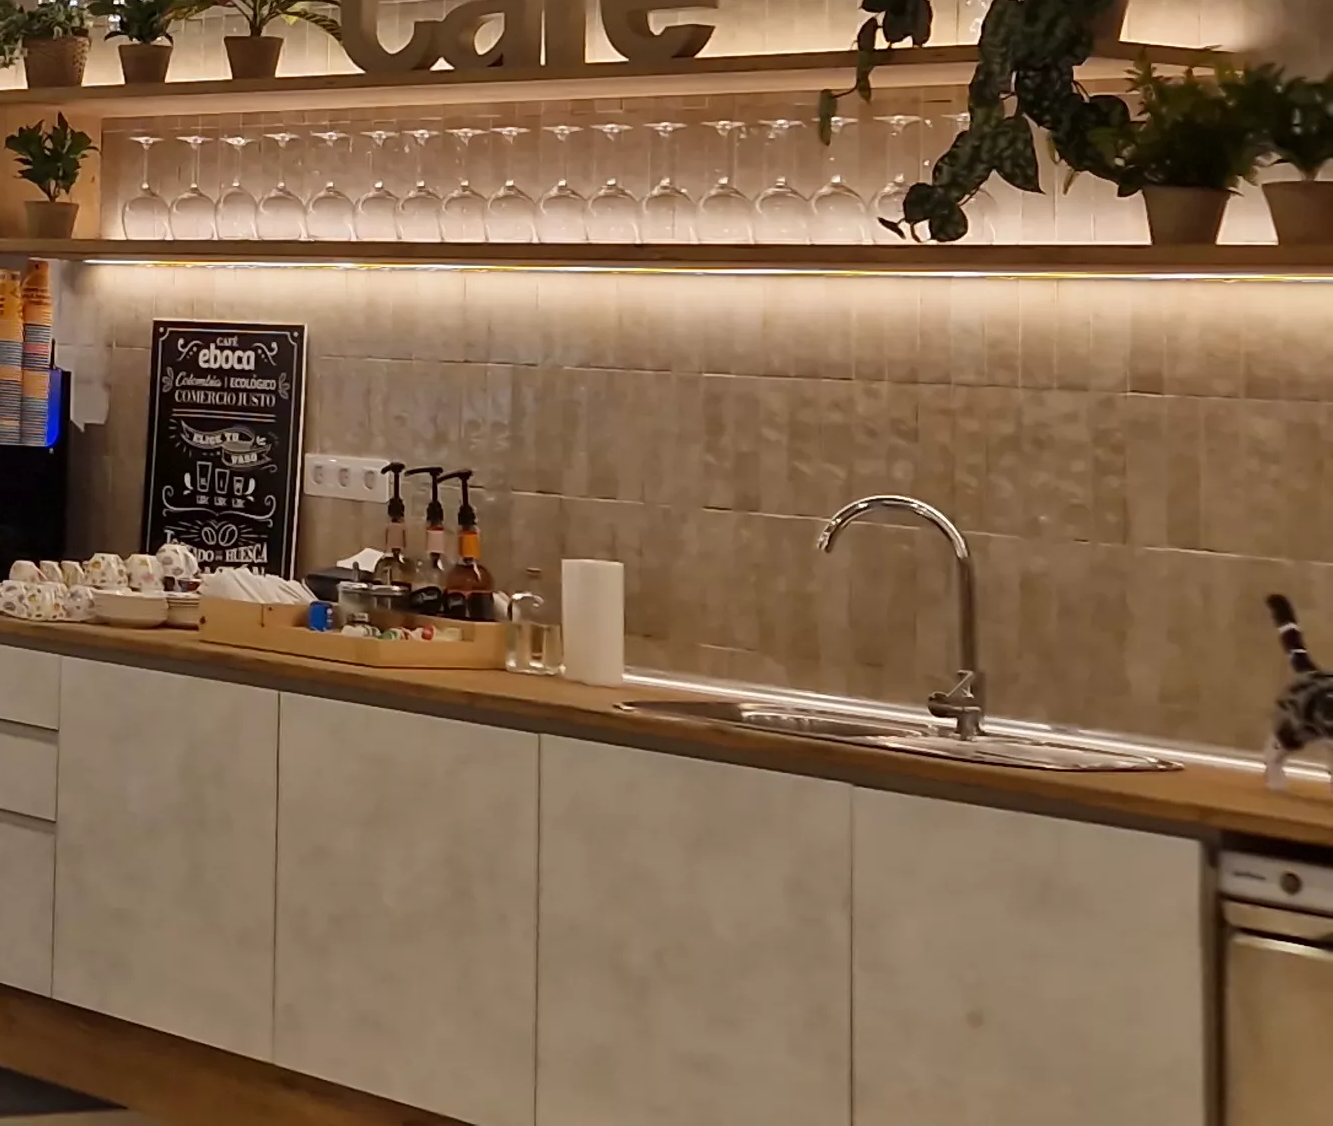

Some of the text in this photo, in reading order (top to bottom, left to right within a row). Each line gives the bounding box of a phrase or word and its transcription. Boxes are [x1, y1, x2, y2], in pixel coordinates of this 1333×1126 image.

[198, 343, 255, 370] eboca
[174, 389, 276, 407] COMERCIO JUSTO
[225, 542, 268, 564] HUESCA
